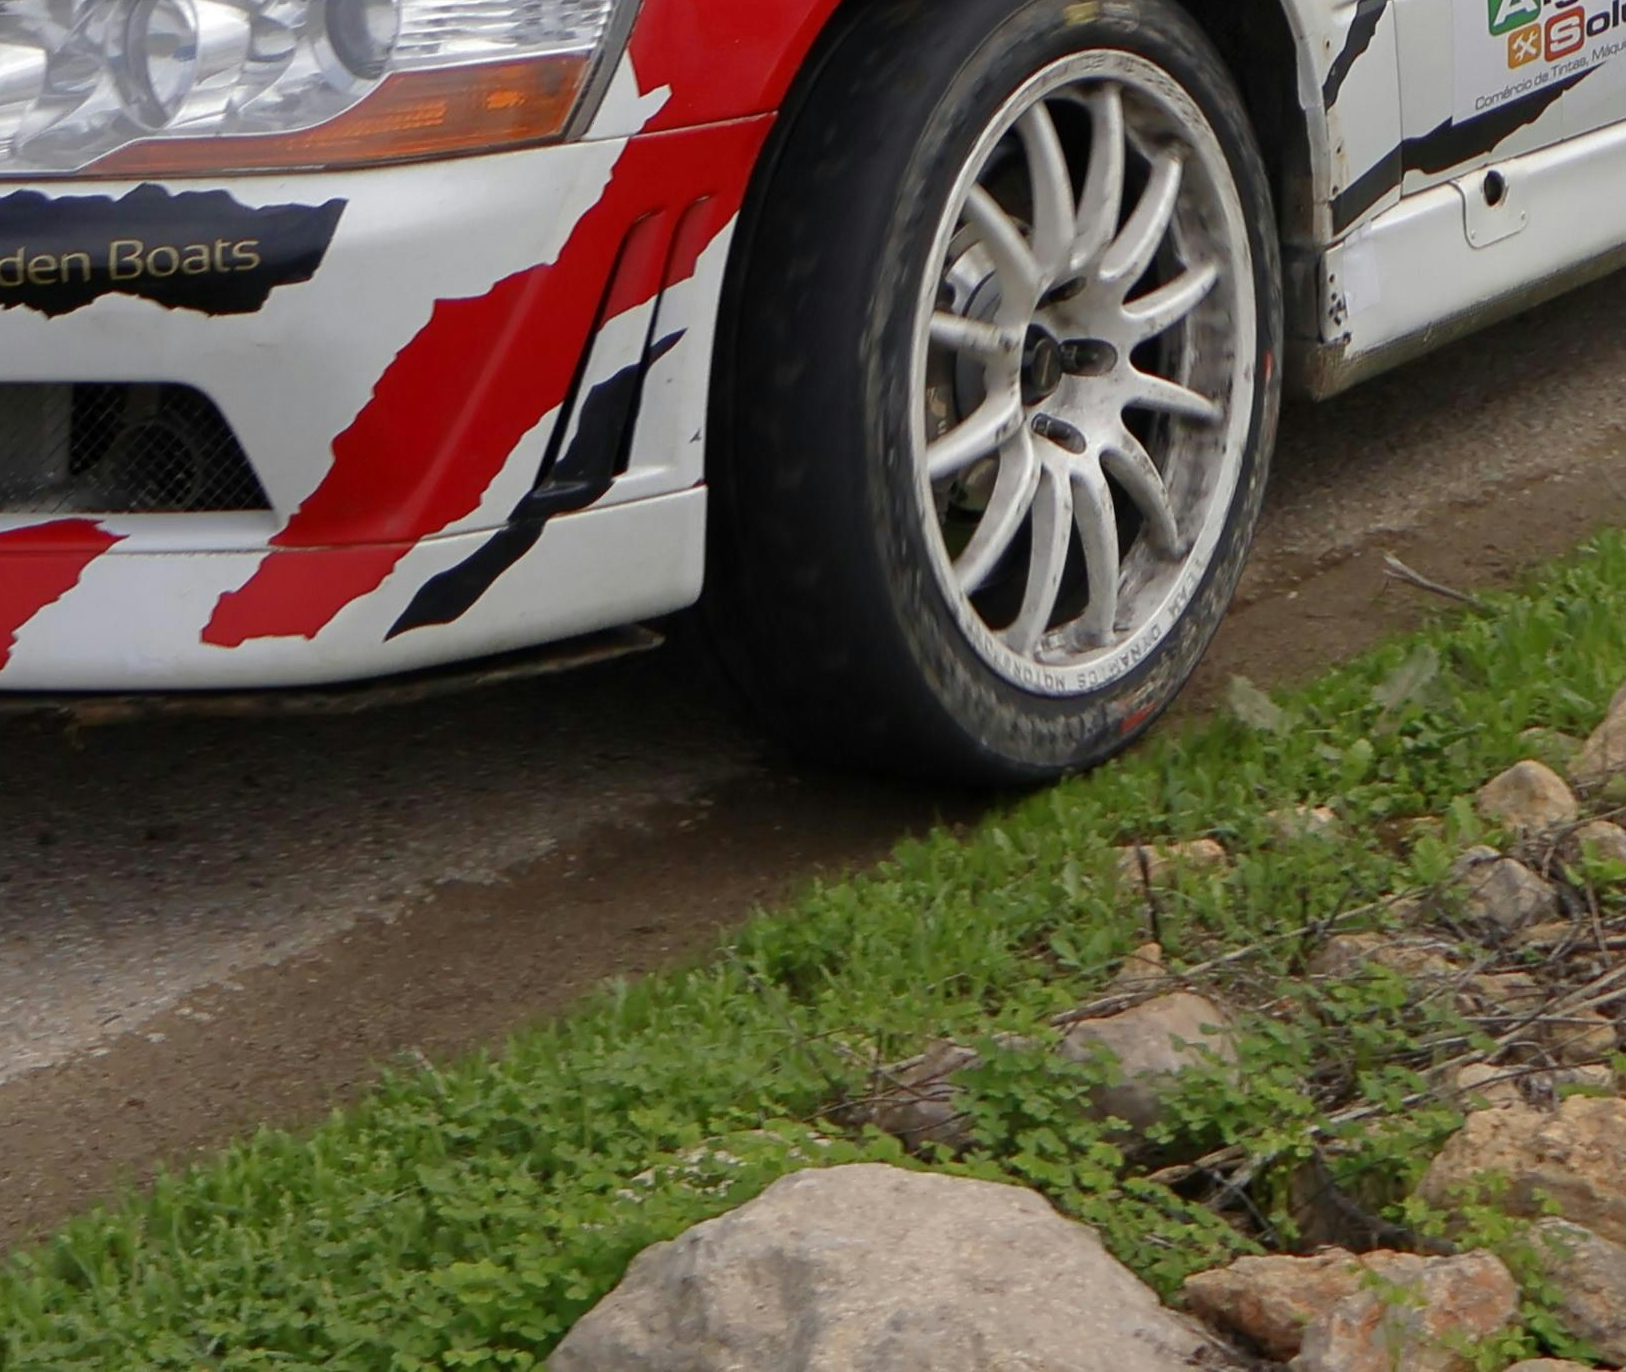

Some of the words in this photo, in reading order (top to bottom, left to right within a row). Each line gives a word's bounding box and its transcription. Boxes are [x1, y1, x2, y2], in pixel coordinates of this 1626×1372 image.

[1475, 78, 1534, 111] Comércio
[1534, 71, 1549, 85] de
[108, 235, 261, 279] Boats
